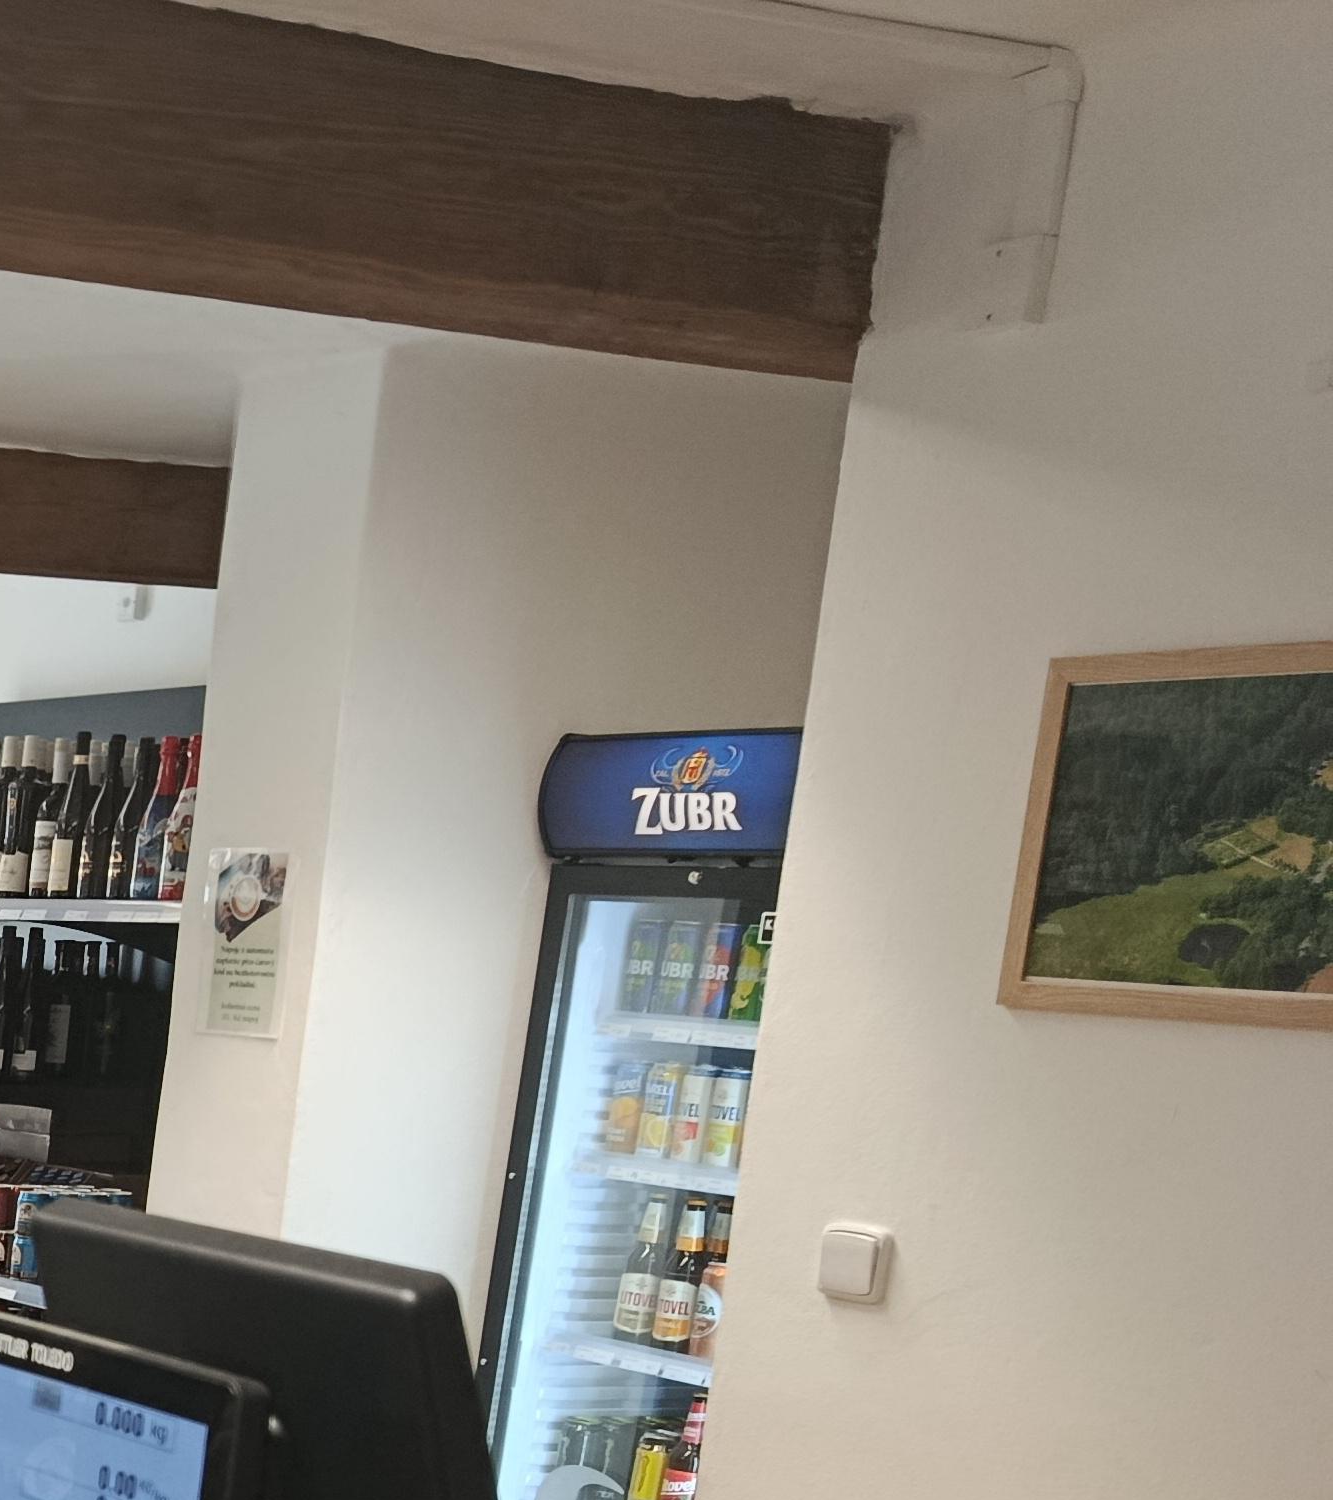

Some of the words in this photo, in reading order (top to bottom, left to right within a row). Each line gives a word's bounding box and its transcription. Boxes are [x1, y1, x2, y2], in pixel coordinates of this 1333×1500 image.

[632, 787, 743, 835] ZUBR
[95, 1401, 145, 1437] 0.000
[151, 1424, 167, 1445] kg
[98, 1465, 138, 1500] 0.00
